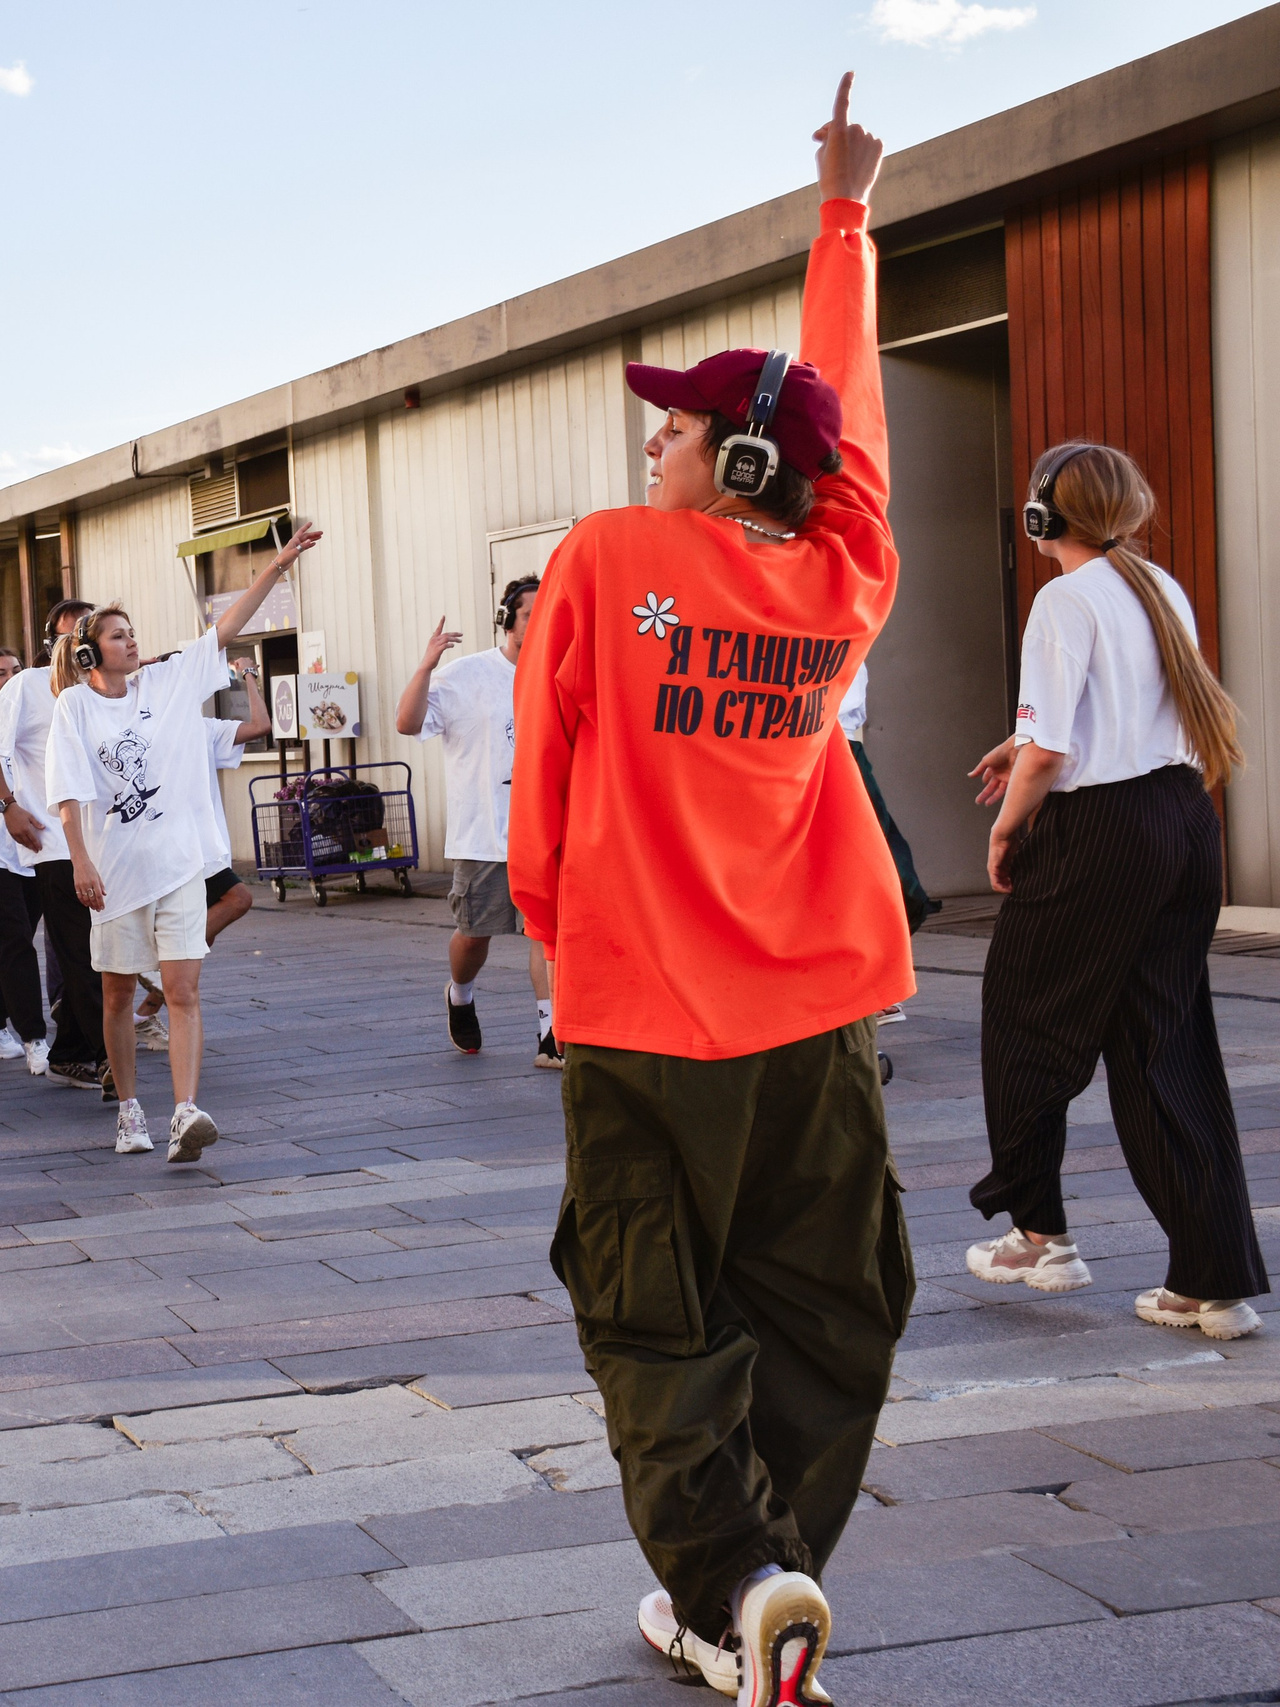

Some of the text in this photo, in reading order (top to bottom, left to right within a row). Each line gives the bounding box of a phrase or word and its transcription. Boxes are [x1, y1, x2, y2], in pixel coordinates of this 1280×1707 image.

[730, 475, 755, 485] ВНУТРИ
[731, 469, 756, 481] ГОЛОС
[666, 625, 851, 693] Я ТАНЦУЮ
[308, 682, 347, 699] Шаурма
[653, 683, 829, 740] ПО СТРАНЕ
